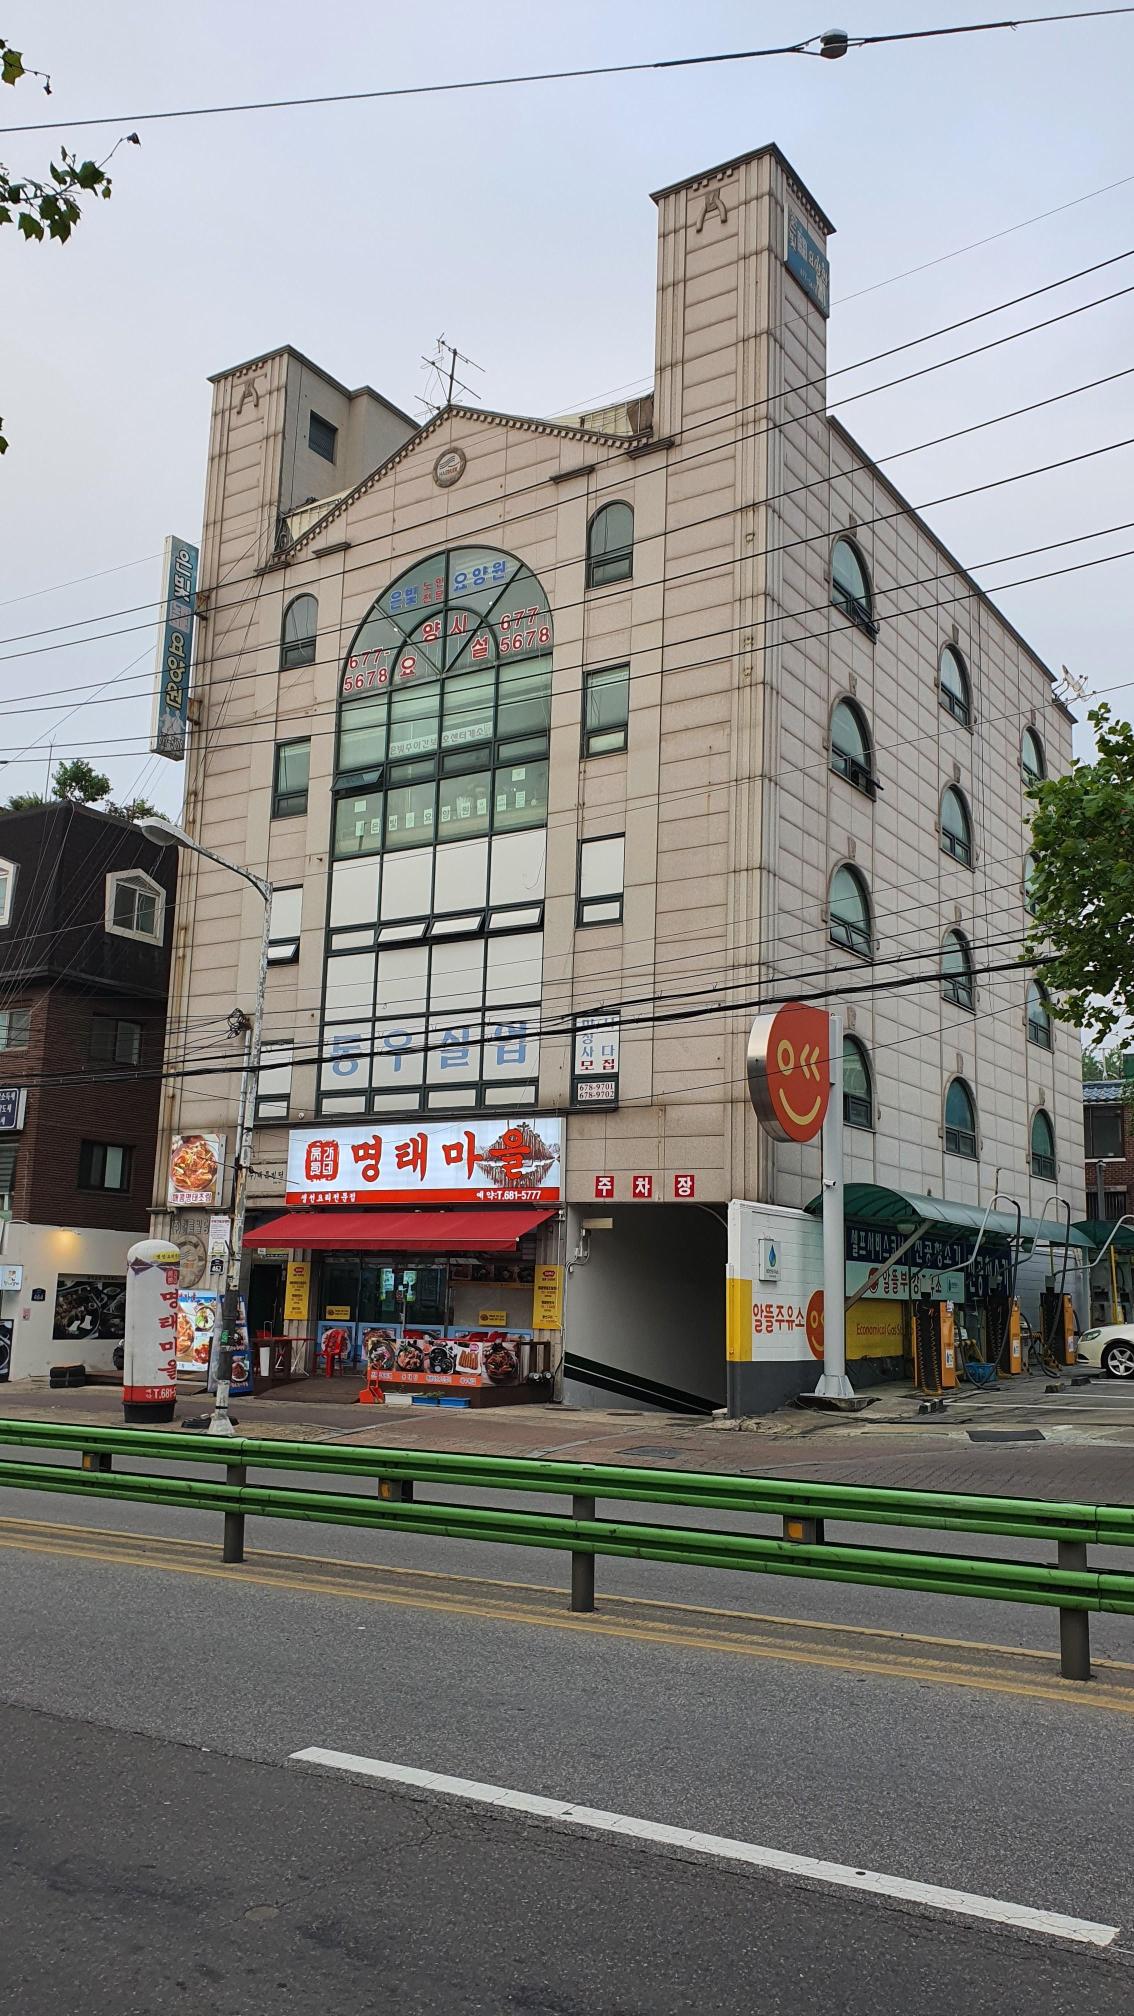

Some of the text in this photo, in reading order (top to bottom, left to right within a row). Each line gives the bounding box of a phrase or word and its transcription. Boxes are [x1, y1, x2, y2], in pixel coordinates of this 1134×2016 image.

[453, 560, 506, 592] 요양원
[499, 626, 550, 654] 5678
[165, 631, 186, 710] 요양원
[344, 667, 388, 692] 5678
[580, 1058, 616, 1072] 모집
[579, 1083, 613, 1092] 678-9701
[579, 1090, 614, 1100] 678-9702
[351, 1128, 531, 1183] 명태마을
[597, 1176, 693, 1197] 주차장
[752, 1303, 805, 1334] 알뜰주유소
